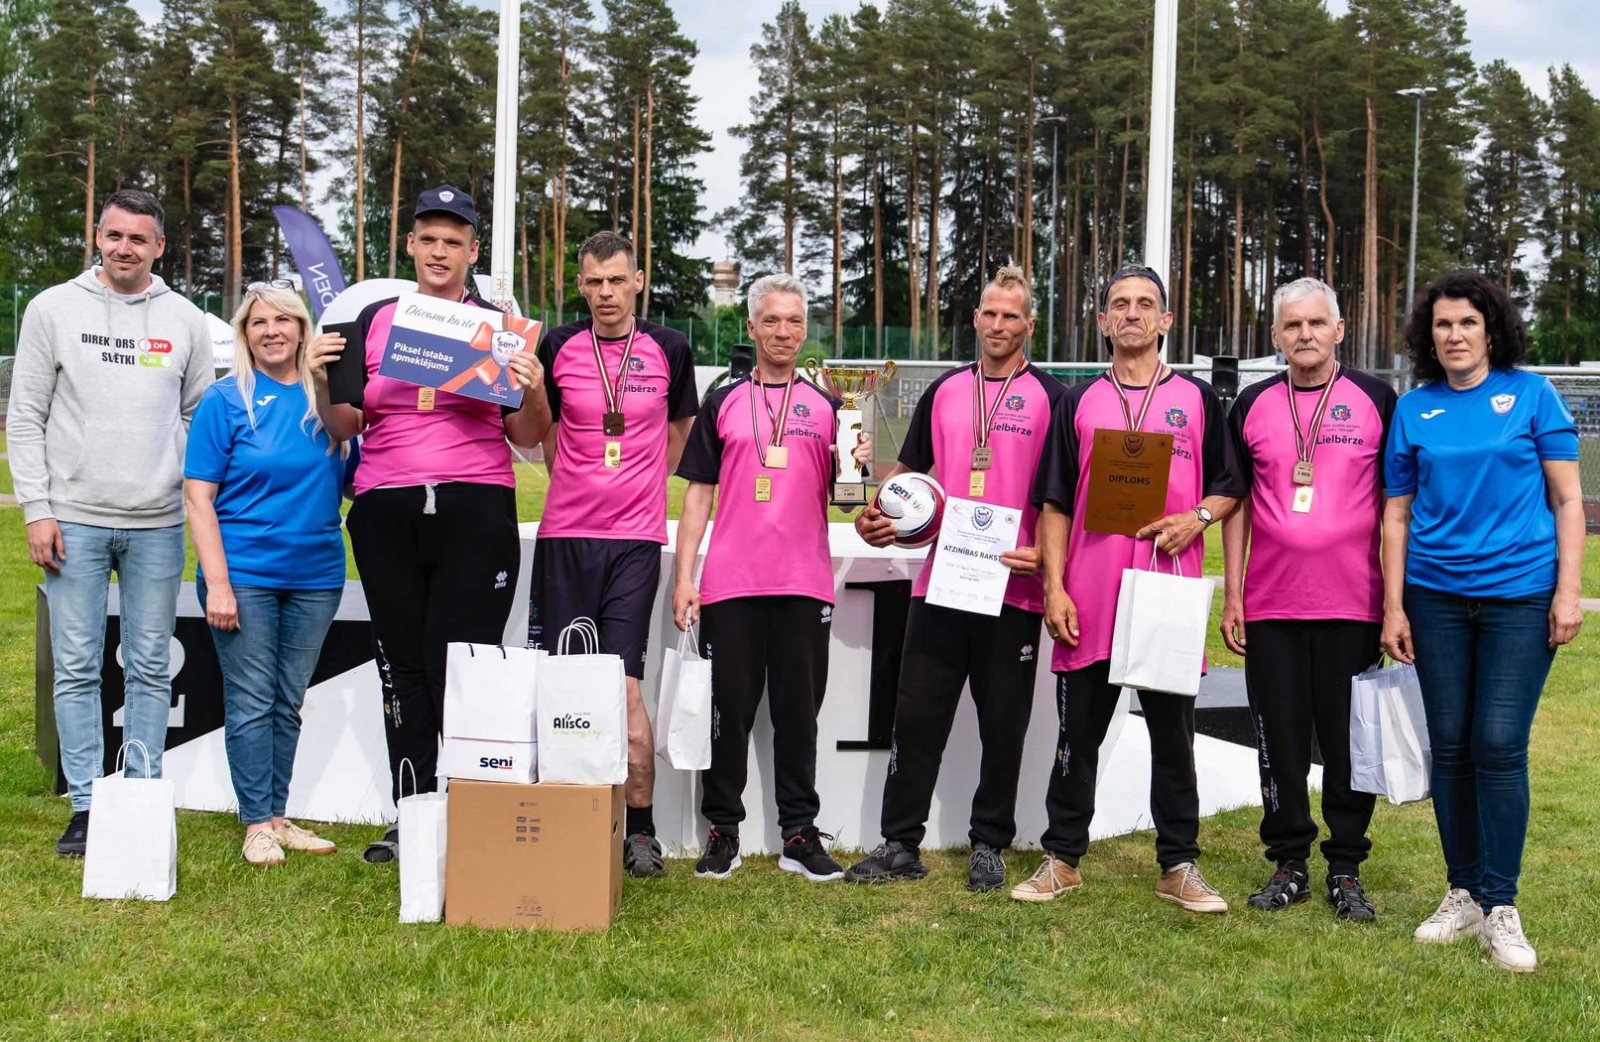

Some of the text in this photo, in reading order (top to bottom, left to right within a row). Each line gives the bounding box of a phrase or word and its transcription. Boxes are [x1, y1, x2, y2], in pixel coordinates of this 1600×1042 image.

[446, 314, 476, 329] karte
[81, 333, 135, 349] DIREKORS
[153, 342, 168, 350] OFF
[393, 341, 454, 363] Piksel istabas
[391, 353, 450, 372] apmeklējums
[1316, 434, 1364, 446] Lielbērze
[1108, 474, 1151, 486] DIPLOMS
[888, 482, 915, 501] seni
[943, 544, 1002, 563] ATZINĪBAS RAKST
[553, 714, 591, 729] AlisCo
[479, 756, 513, 769] seni
